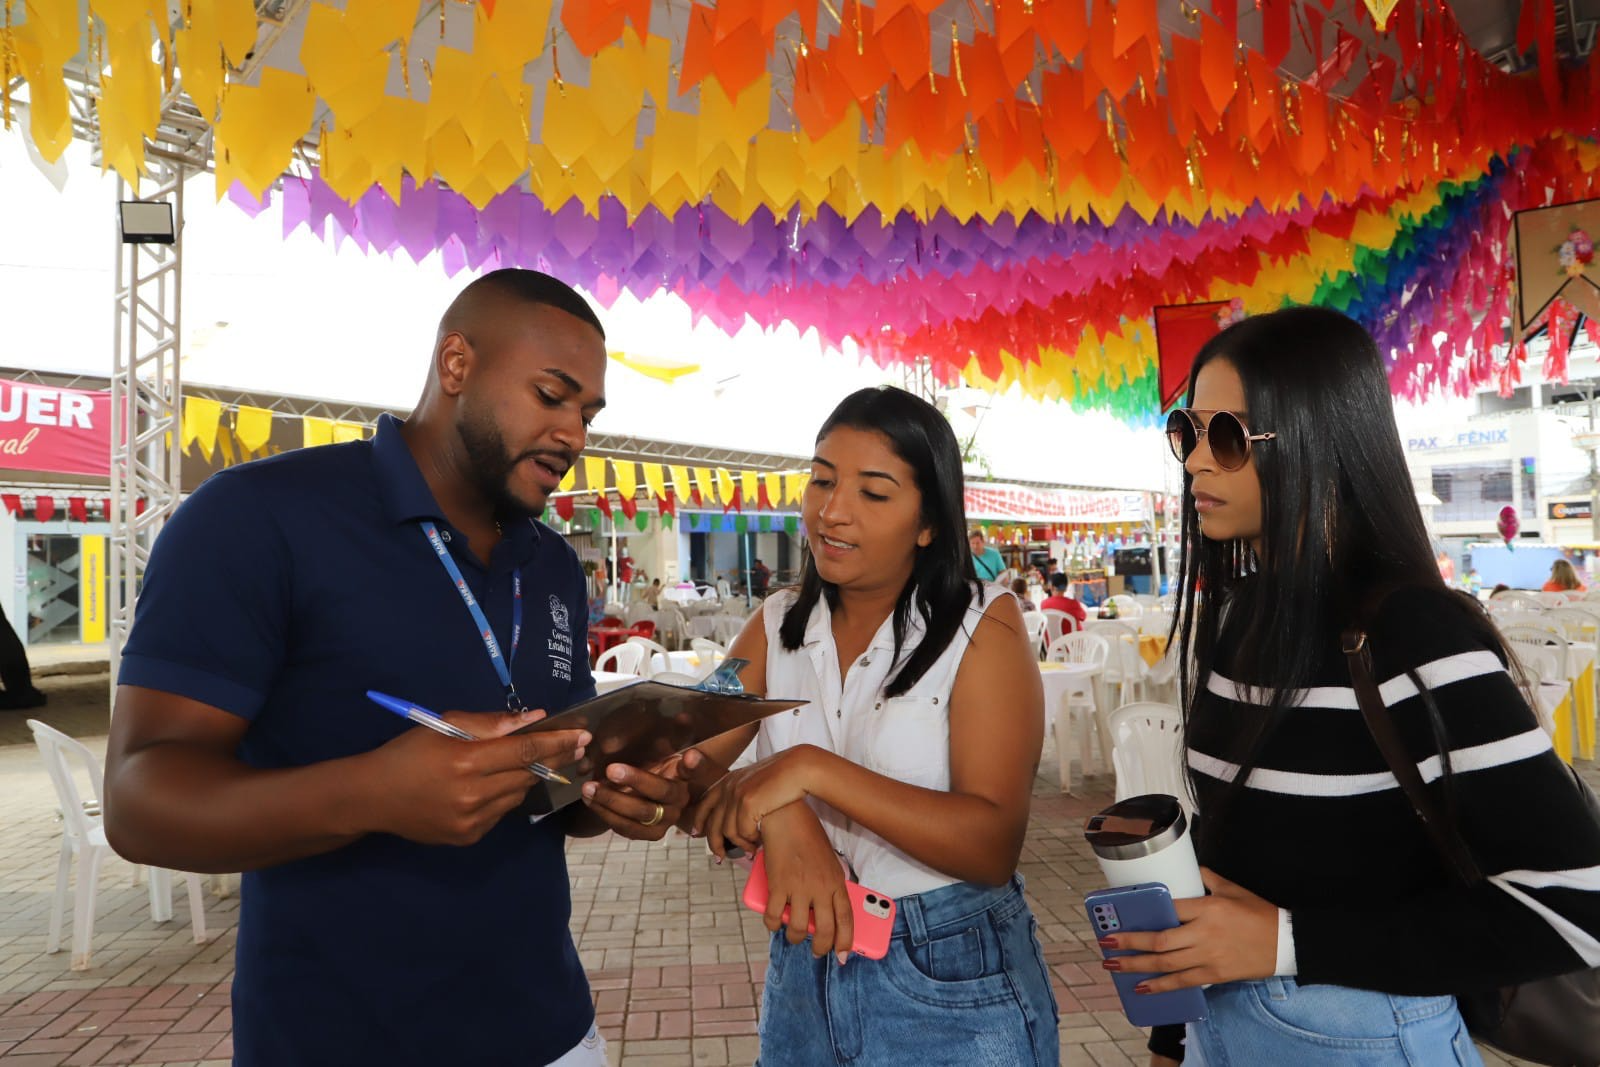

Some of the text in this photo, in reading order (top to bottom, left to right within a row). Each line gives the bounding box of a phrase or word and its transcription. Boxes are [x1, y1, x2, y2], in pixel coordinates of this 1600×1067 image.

[0, 386, 94, 429] UER
[1408, 428, 1509, 449] PAX FÊNIX
[485, 635, 500, 658] BAHIA
